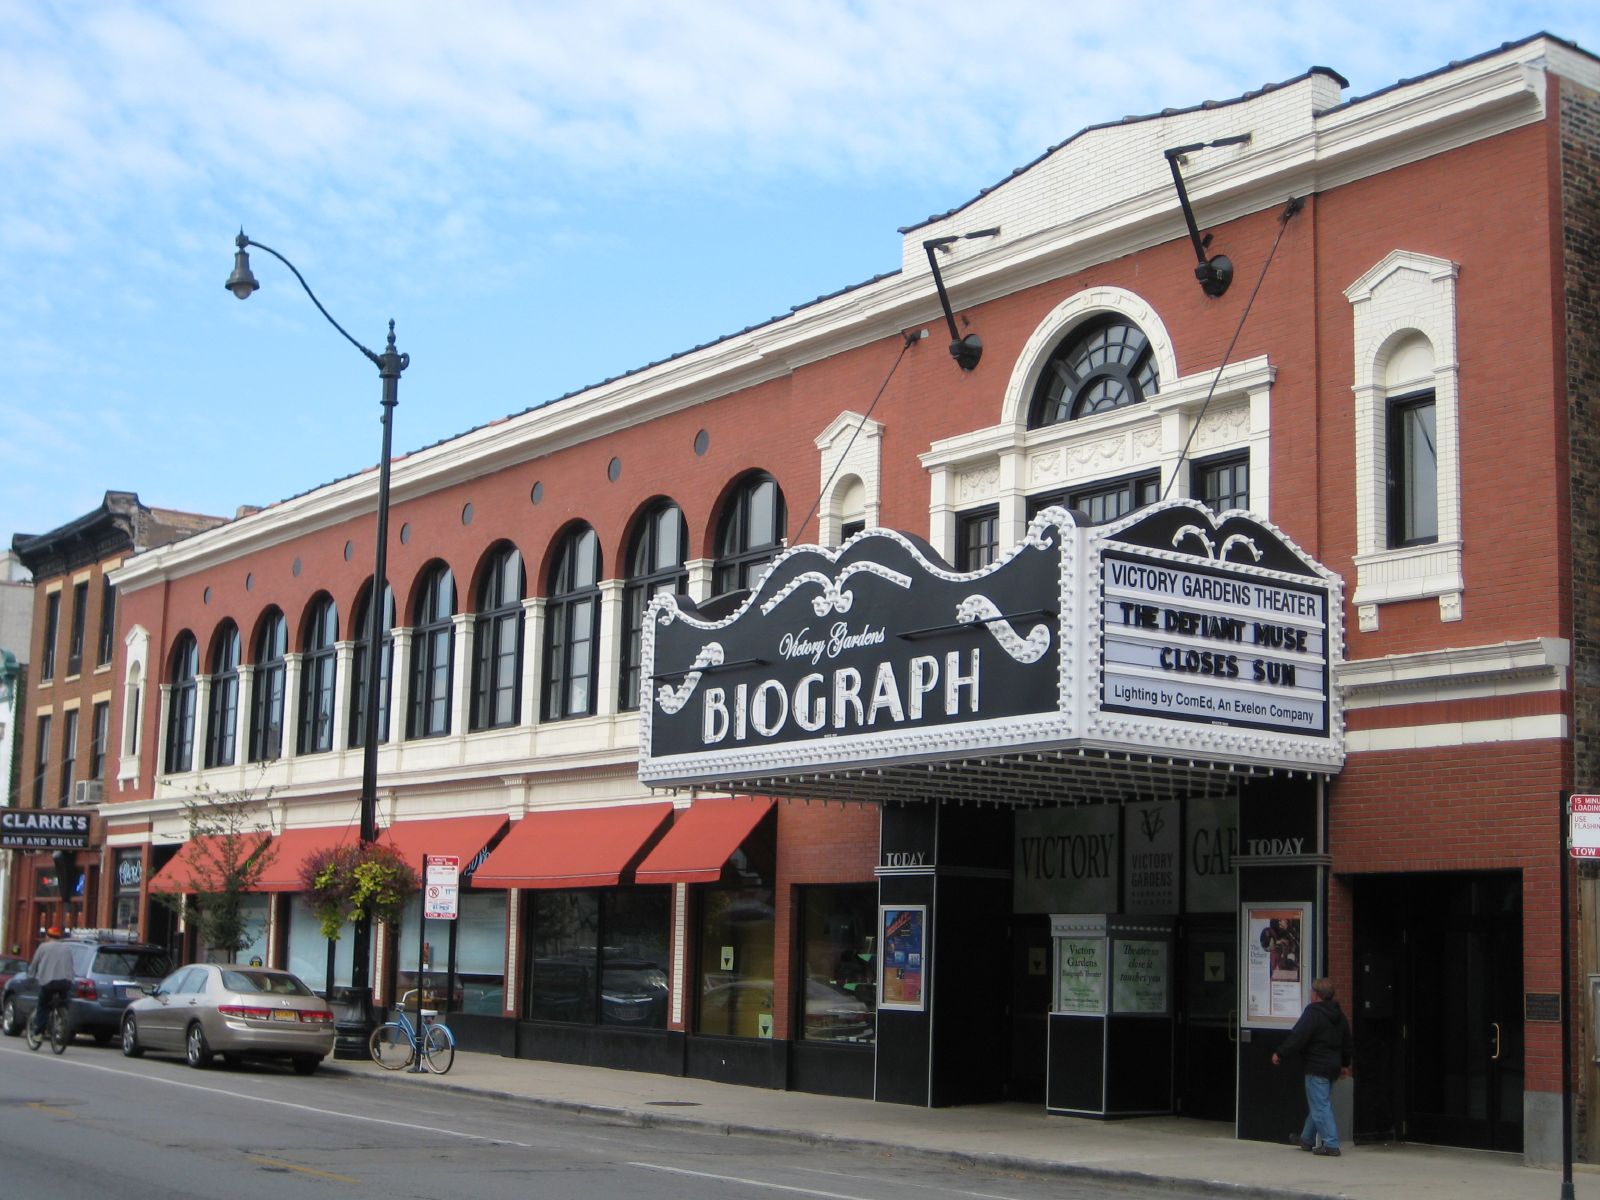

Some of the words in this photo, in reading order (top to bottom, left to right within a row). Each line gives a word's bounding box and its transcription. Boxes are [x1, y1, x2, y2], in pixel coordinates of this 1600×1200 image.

[1112, 562, 1178, 594] VICTORY
[1182, 575, 1251, 606] GARDENS
[1255, 588, 1316, 617] THEATER
[1120, 601, 1160, 630] THE
[1165, 608, 1246, 643] DEFIANT
[1253, 622, 1308, 652] MUSE
[779, 626, 826, 665] Victory
[826, 621, 886, 659] Gardens
[1160, 646, 1240, 679] CLOSES
[1253, 659, 1296, 687] SUN
[702, 648, 980, 745] BIOGRAPH
[1114, 684, 1158, 706] Lighting
[1160, 688, 1173, 706] by
[1176, 692, 1215, 712] ComEd,
[1218, 698, 1231, 712] An
[1234, 701, 1267, 716] Exelon
[1270, 704, 1314, 724] Company
[3, 814, 87, 830] CLARKE'S
[3, 836, 24, 846] BAR
[26, 837, 48, 846] AND
[50, 837, 84, 847] GRILLE
[1247, 837, 1304, 857] TODAY
[886, 852, 925, 866] TODAY
[1021, 833, 1115, 880] VICTORY
[1575, 847, 1596, 856] TOW
[1131, 853, 1174, 869] VICTORY
[1131, 871, 1173, 888] GARDENS
[1069, 943, 1097, 958] Victory
[1067, 957, 1098, 968] Gardens
